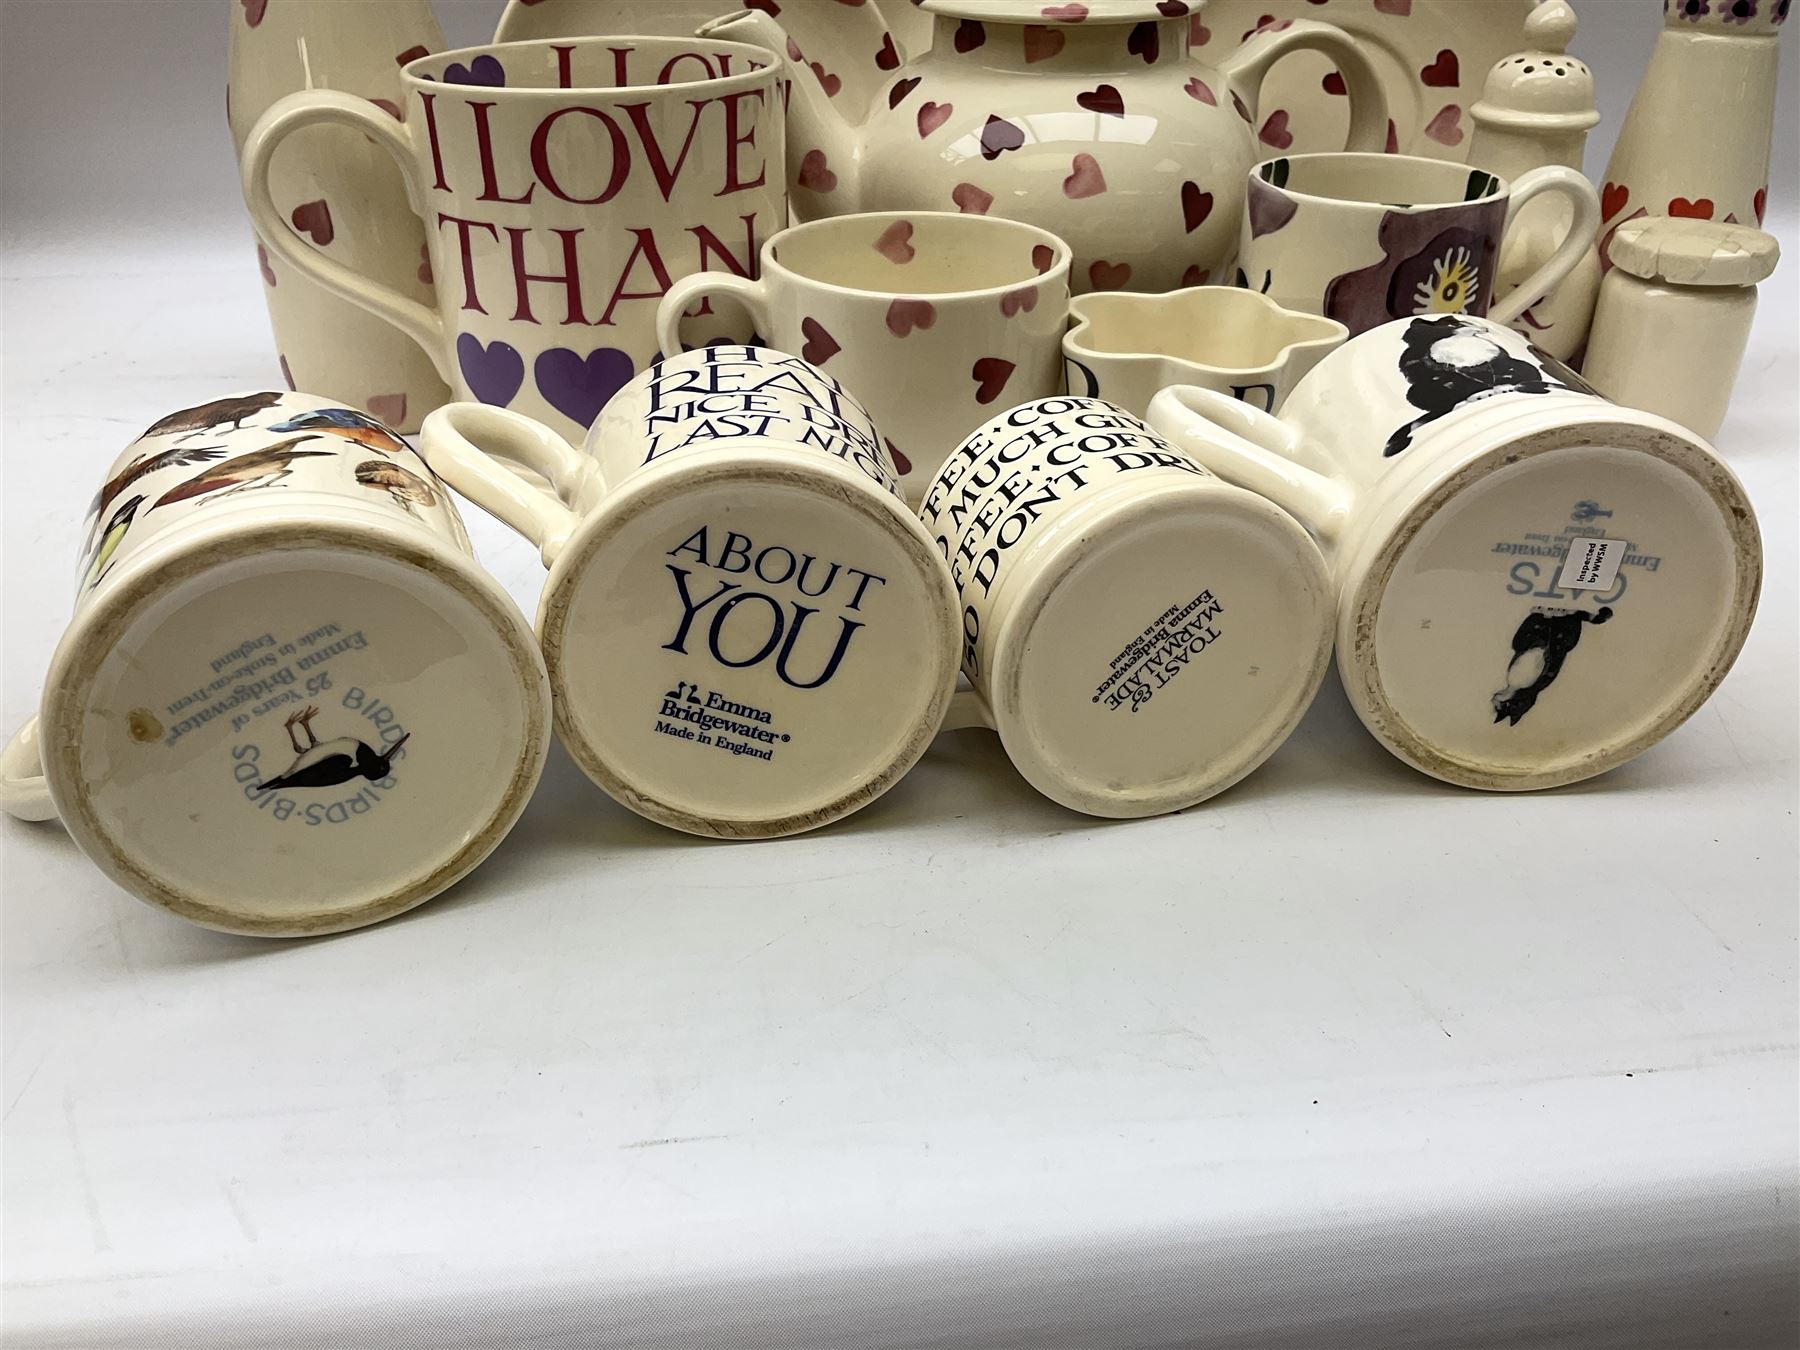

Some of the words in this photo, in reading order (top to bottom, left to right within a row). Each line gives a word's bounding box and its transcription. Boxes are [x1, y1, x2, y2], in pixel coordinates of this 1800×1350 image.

[417, 90, 454, 194] I
[465, 88, 766, 205] LOVE
[438, 212, 758, 326] THAN
[645, 392, 782, 437] NICE
[640, 414, 790, 468] LAST
[920, 432, 993, 526] FEE
[948, 420, 1070, 534] MUCH
[972, 464, 1089, 600] DON'T
[666, 525, 887, 611] ABOUT
[1576, 543, 1597, 583] Inspected
[1587, 571, 1597, 584] by
[1591, 543, 1609, 572] WWSM
[661, 564, 866, 689] YOU
[1154, 604, 1180, 628] Made
[1168, 589, 1214, 628] Emma
[278, 643, 297, 658] in
[296, 622, 342, 646] Made
[1144, 625, 1156, 636] in
[209, 632, 277, 674] England
[296, 630, 369, 672] Emma
[1103, 599, 1224, 711] MARMALADE
[1109, 634, 1146, 670] England
[1156, 626, 1222, 689] TOAST
[251, 688, 304, 718] Years
[304, 670, 333, 698] 25
[1131, 683, 1153, 713] &
[231, 713, 250, 734] of
[704, 690, 772, 724] Emma
[654, 720, 702, 742] Made
[698, 731, 712, 745] in
[714, 735, 773, 760] England
